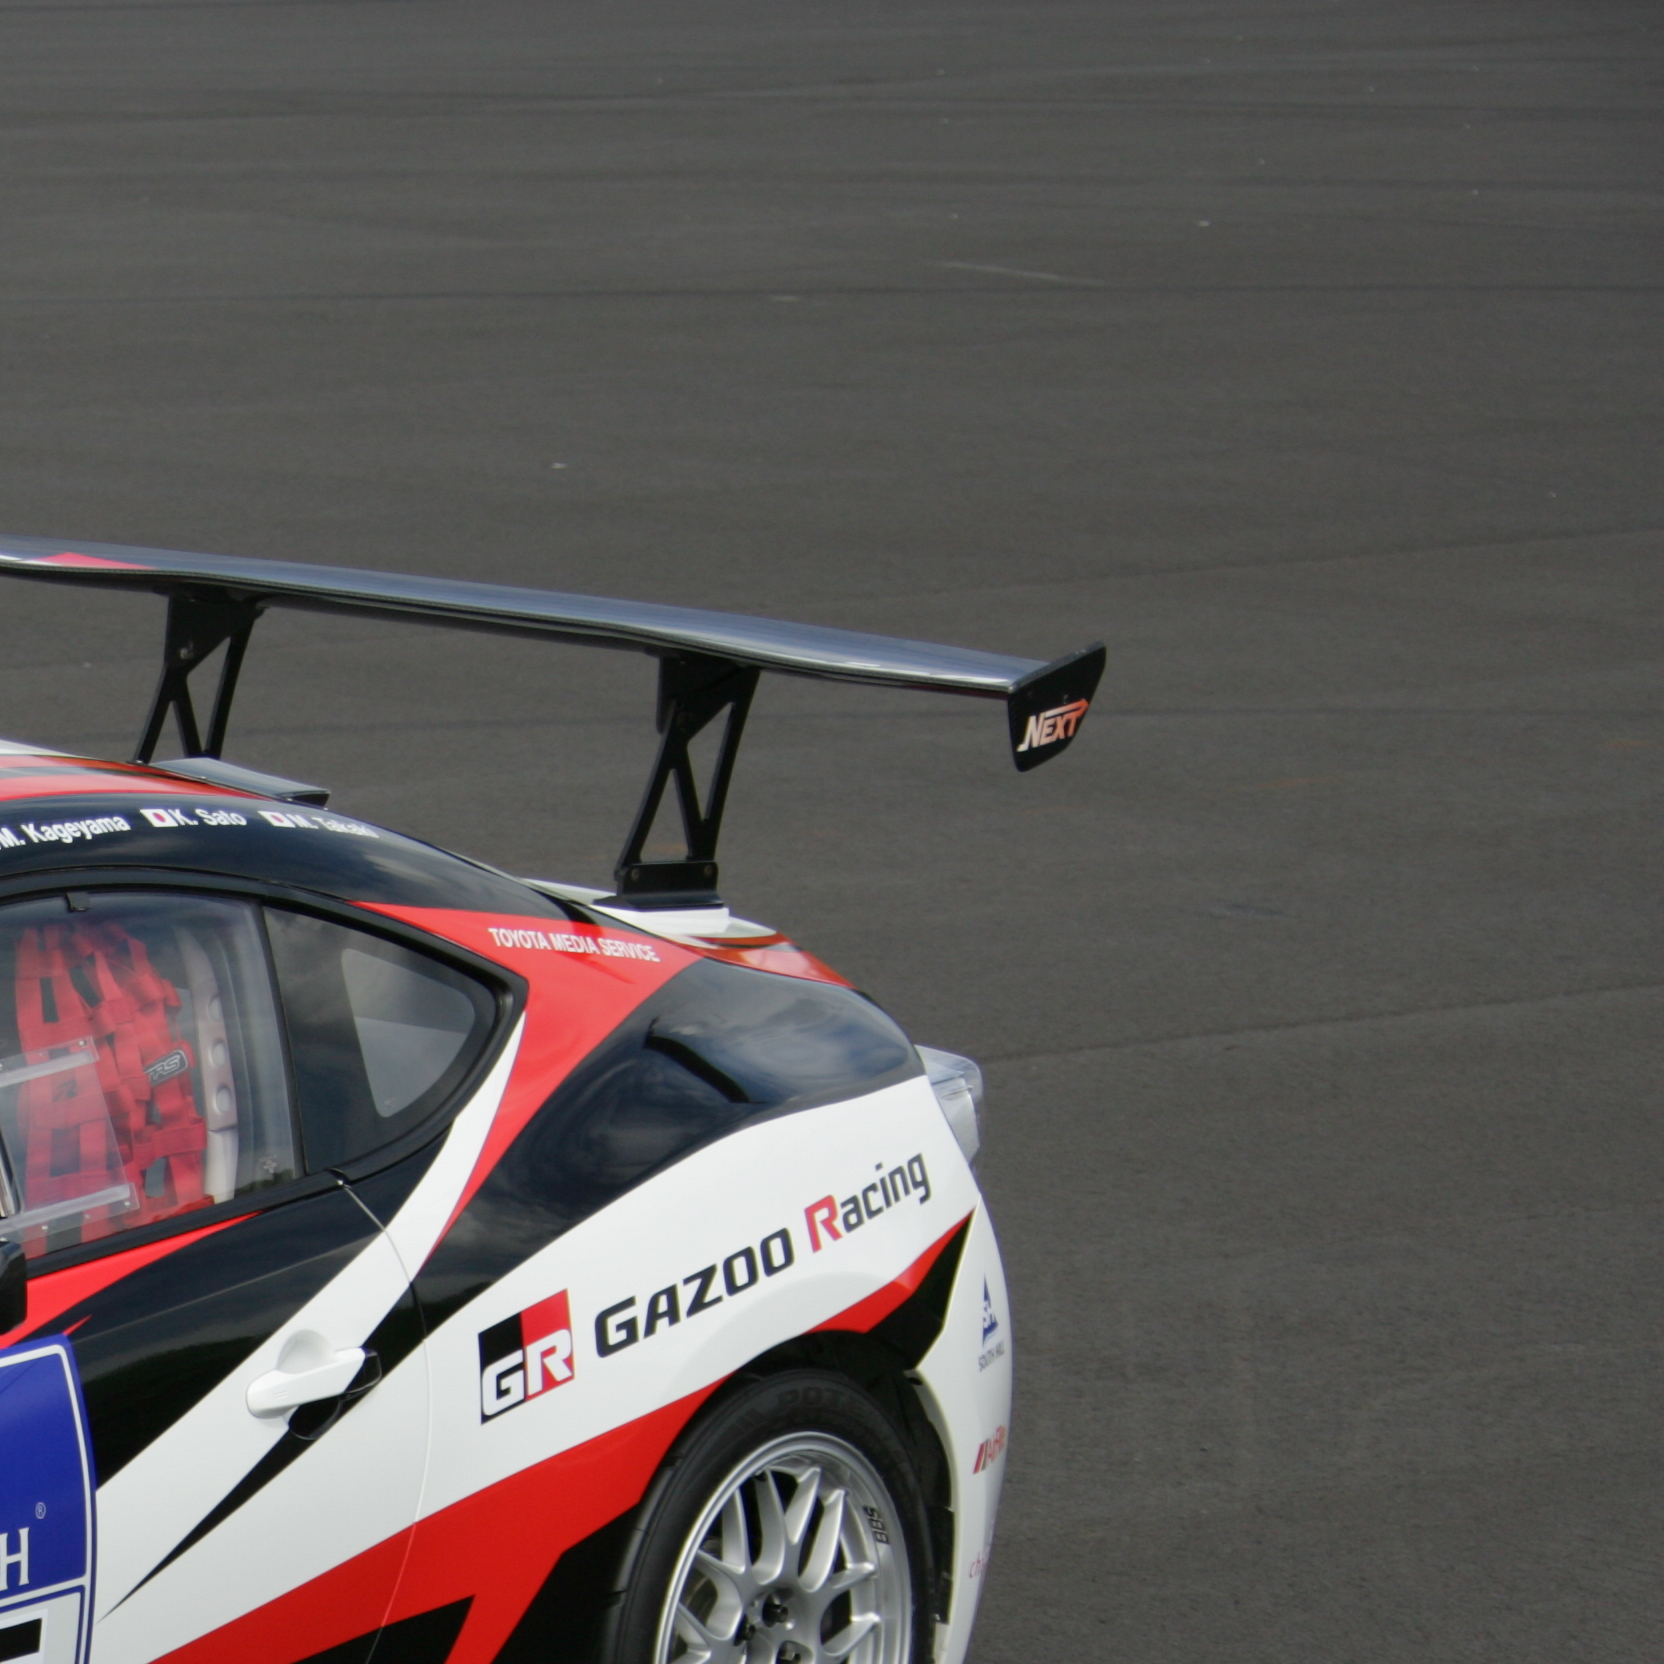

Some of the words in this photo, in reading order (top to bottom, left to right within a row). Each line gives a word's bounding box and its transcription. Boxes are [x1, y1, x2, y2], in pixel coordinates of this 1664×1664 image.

[1016, 699, 1090, 752] NEXT
[21, 814, 131, 844] Kageyama
[168, 809, 198, 826] K.
[195, 808, 248, 827] Sato
[488, 927, 551, 951] TOYOTA
[548, 932, 601, 954] MEDIA
[598, 937, 661, 963] SERVICE
[482, 1328, 574, 1417] GR
[593, 1227, 795, 1359] GAZOO
[803, 1152, 932, 1254] Racing
